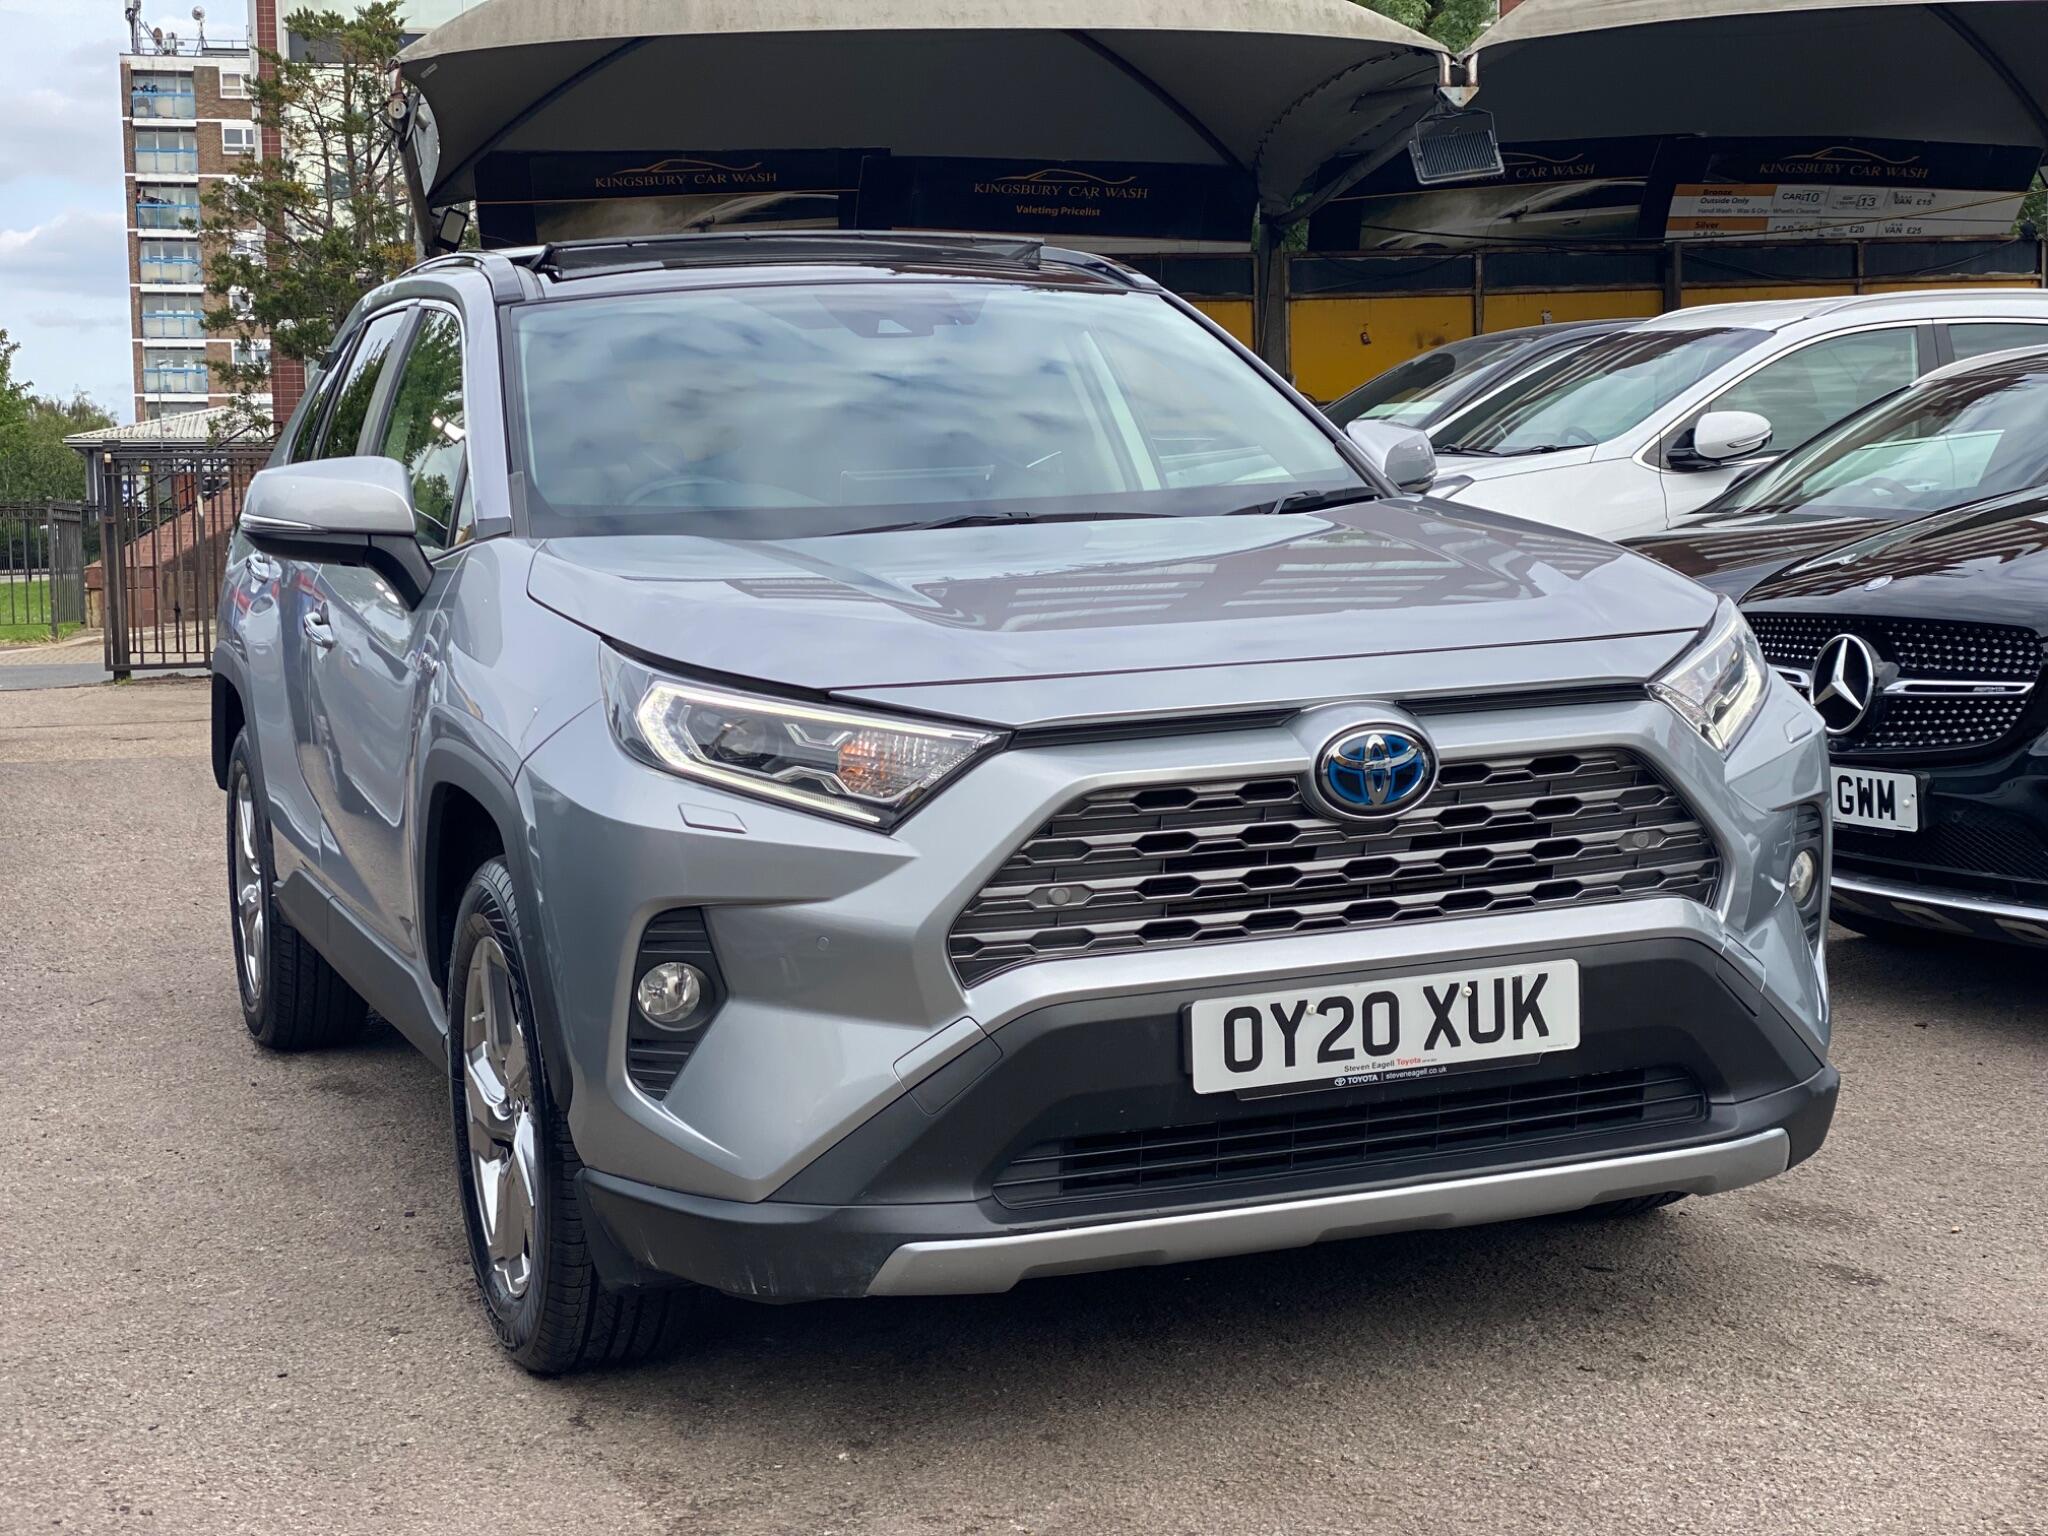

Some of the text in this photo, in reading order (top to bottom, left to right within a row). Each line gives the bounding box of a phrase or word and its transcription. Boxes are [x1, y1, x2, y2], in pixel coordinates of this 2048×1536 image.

[1515, 166, 1547, 179] CAR
[1550, 163, 1596, 176] WASH
[1759, 162, 1929, 179] KINGSBURY CAR WASH
[594, 172, 777, 188] KINGSBURY CAR WASH
[974, 182, 1150, 199] KINGSBURY CAR WASH
[1782, 192, 1801, 200] CAR
[1732, 197, 1750, 205] Only
[1015, 205, 1101, 217] Valeting Pricelist
[1695, 221, 1720, 229] Silver
[1849, 225, 1865, 233] £20
[1884, 226, 1922, 235] VAN £25
[1838, 775, 1896, 820] GWM
[1223, 973, 1549, 1073] OY20 XUK
[1344, 1064, 1370, 1073] Steven
[1371, 1060, 1395, 1070] Eagell
[1396, 1057, 1421, 1066] Toyota
[1348, 1074, 1378, 1085] TOYOTA
